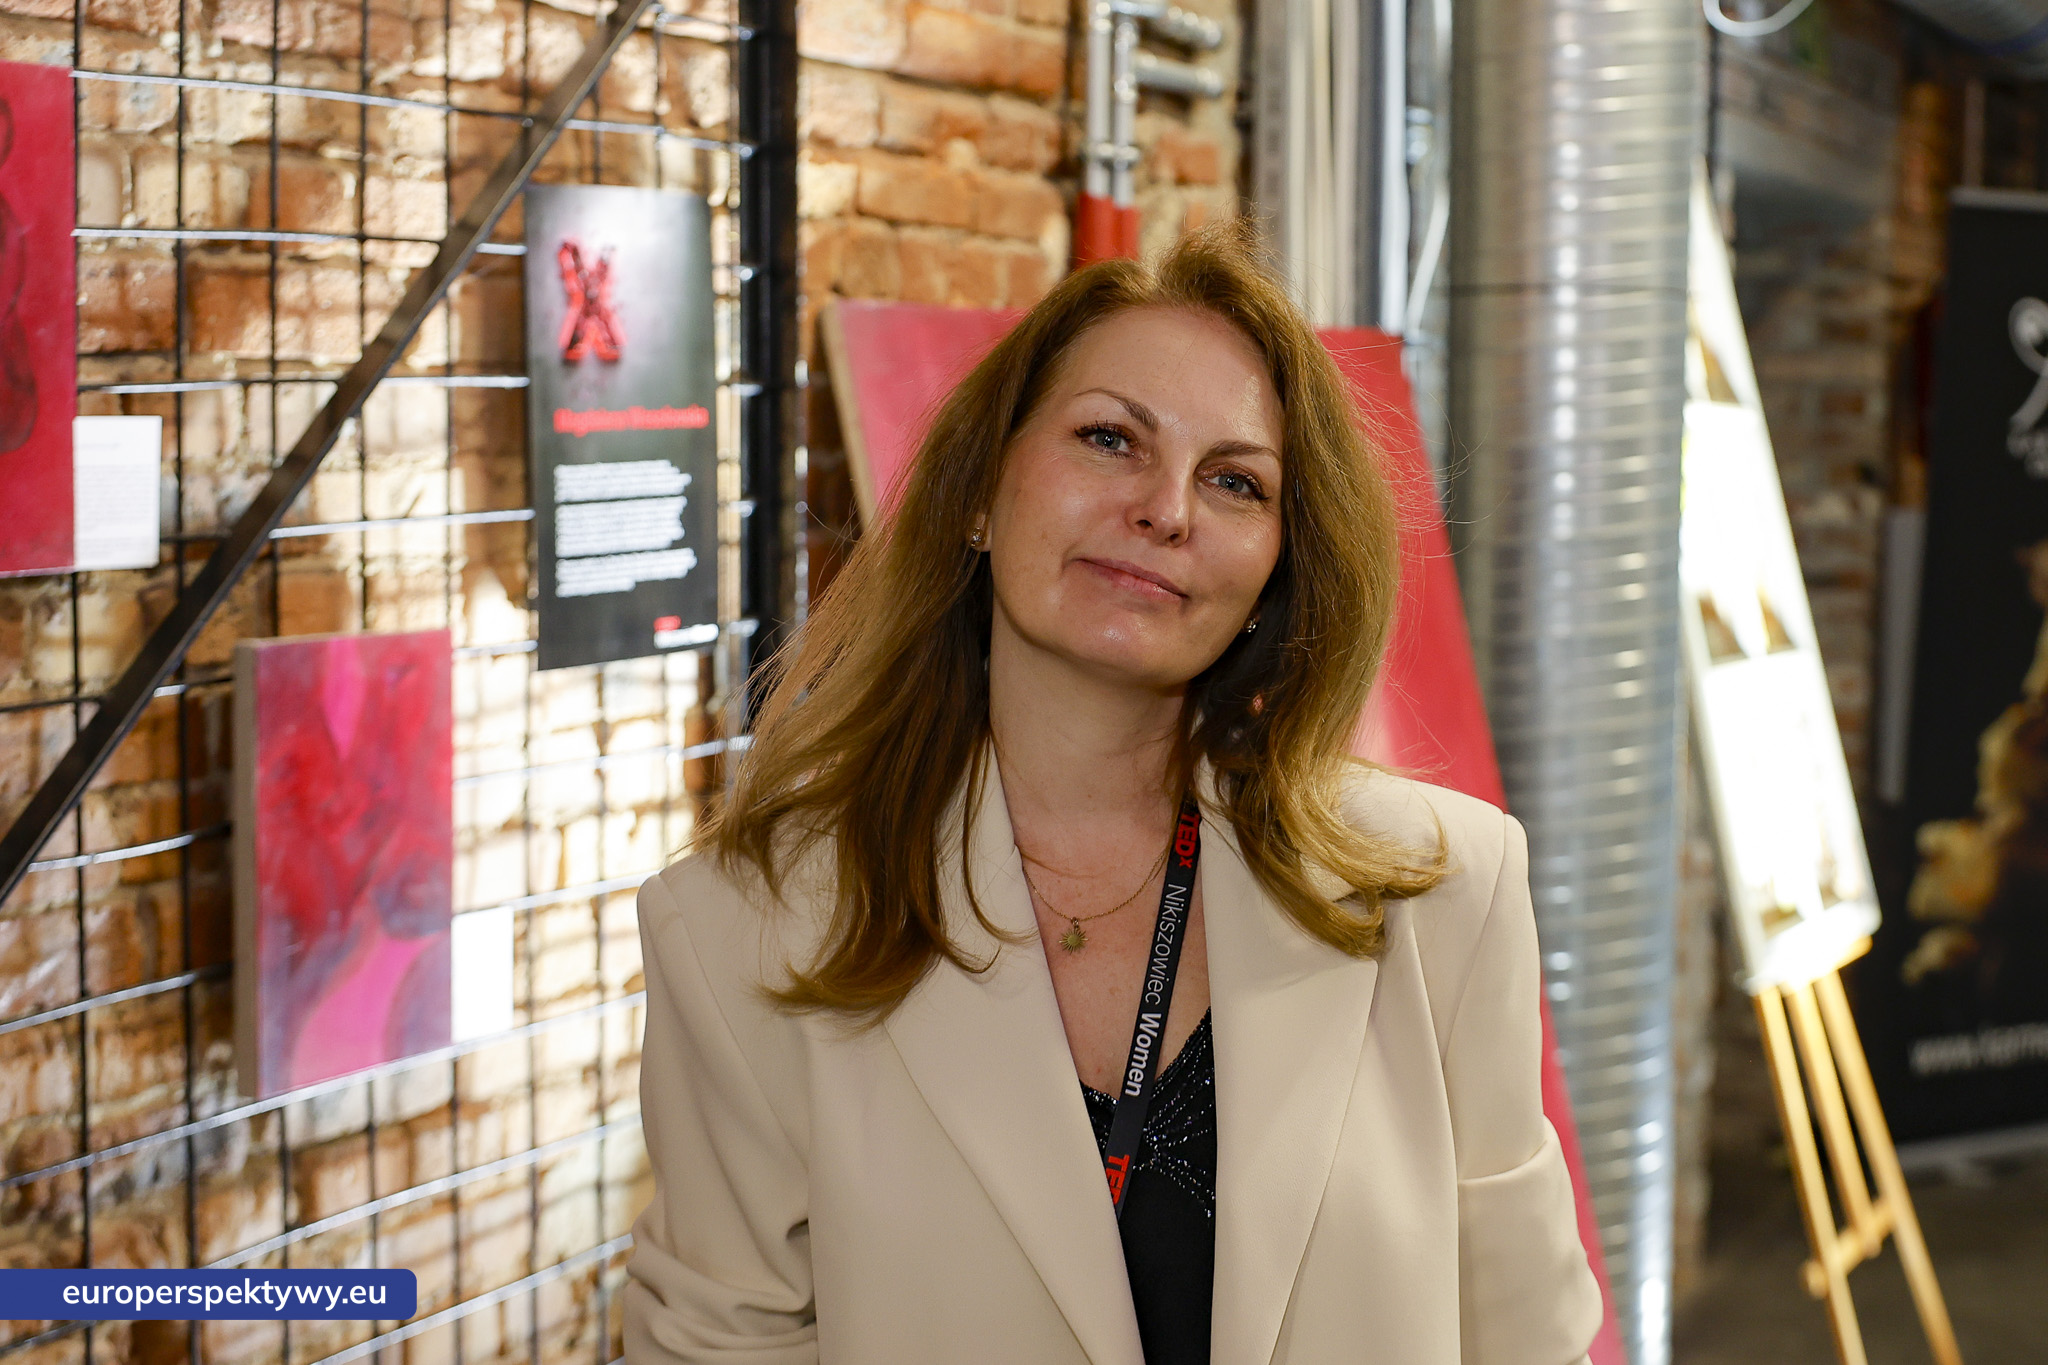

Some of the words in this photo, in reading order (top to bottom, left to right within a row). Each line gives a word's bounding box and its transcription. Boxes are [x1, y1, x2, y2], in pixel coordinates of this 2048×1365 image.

[1175, 813, 1200, 869] TEDx
[1145, 883, 1187, 1005] Nikiszowiec
[1125, 1012, 1162, 1097] Women
